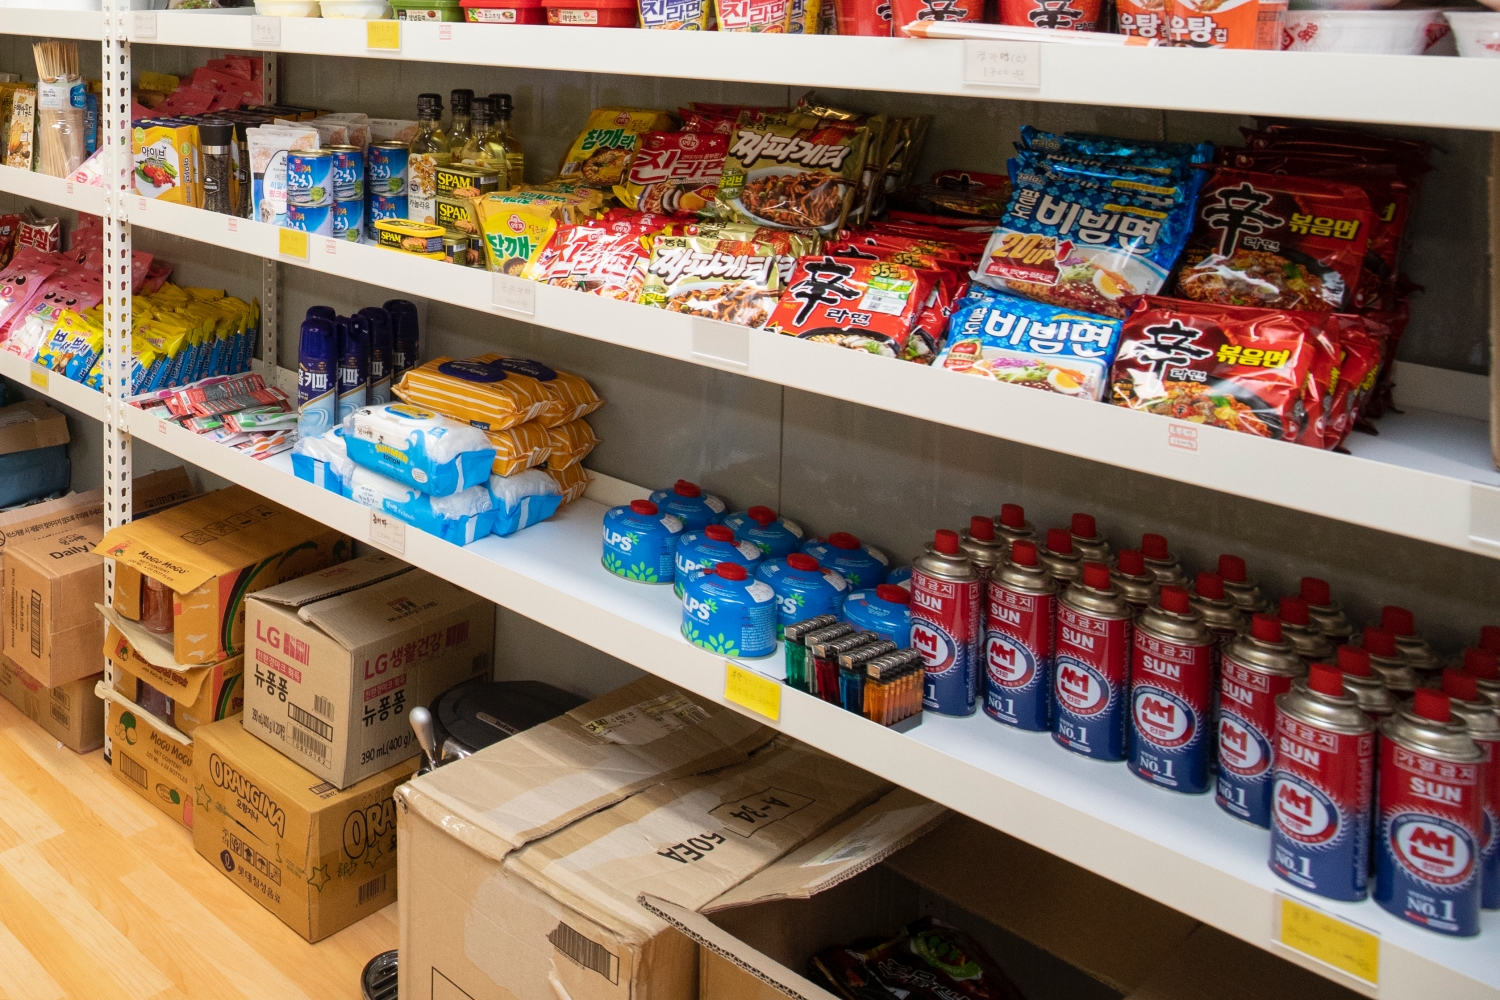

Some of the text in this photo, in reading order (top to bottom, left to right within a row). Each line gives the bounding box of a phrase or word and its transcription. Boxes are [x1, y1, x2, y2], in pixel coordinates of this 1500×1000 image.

[730, 129, 853, 170] 짜파게티
[437, 172, 471, 189] SPAM
[439, 203, 471, 221] SPAM
[1037, 193, 1161, 254] 비빔면
[1202, 182, 1285, 259] 辛
[1289, 213, 1362, 241] 볶음면
[1026, 246, 1055, 265] UP
[782, 256, 861, 326] 辛
[826, 308, 871, 325] 라면
[984, 310, 1114, 358] 비빔면
[1216, 342, 1291, 369] 볶음면
[375, 444, 409, 465] SUMMER
[384, 455, 400, 466] EDITION
[49, 544, 89, 560] Daily
[914, 588, 943, 611] SUN
[990, 601, 1021, 625] SUN
[256, 619, 281, 650] LG
[1135, 633, 1195, 664] 가열금지
[256, 648, 287, 673] 친환경마크
[390, 632, 443, 668] 생활건강
[254, 664, 289, 703] 뉴퐁퐁
[363, 689, 407, 728] 뉴퐁퐁
[150, 731, 170, 752] MOGU
[361, 753, 374, 766] 390
[1140, 755, 1175, 779] NO.1
[1397, 750, 1478, 782] 가열금지
[209, 752, 286, 838] ORANGINA
[236, 798, 259, 823] 오랑지나
[730, 797, 790, 824] A-34
[657, 831, 727, 864] 50EA
[1409, 826, 1456, 862] 썬
[238, 864, 281, 904] 롯데칠성음료
[1408, 894, 1456, 923] NO.1
